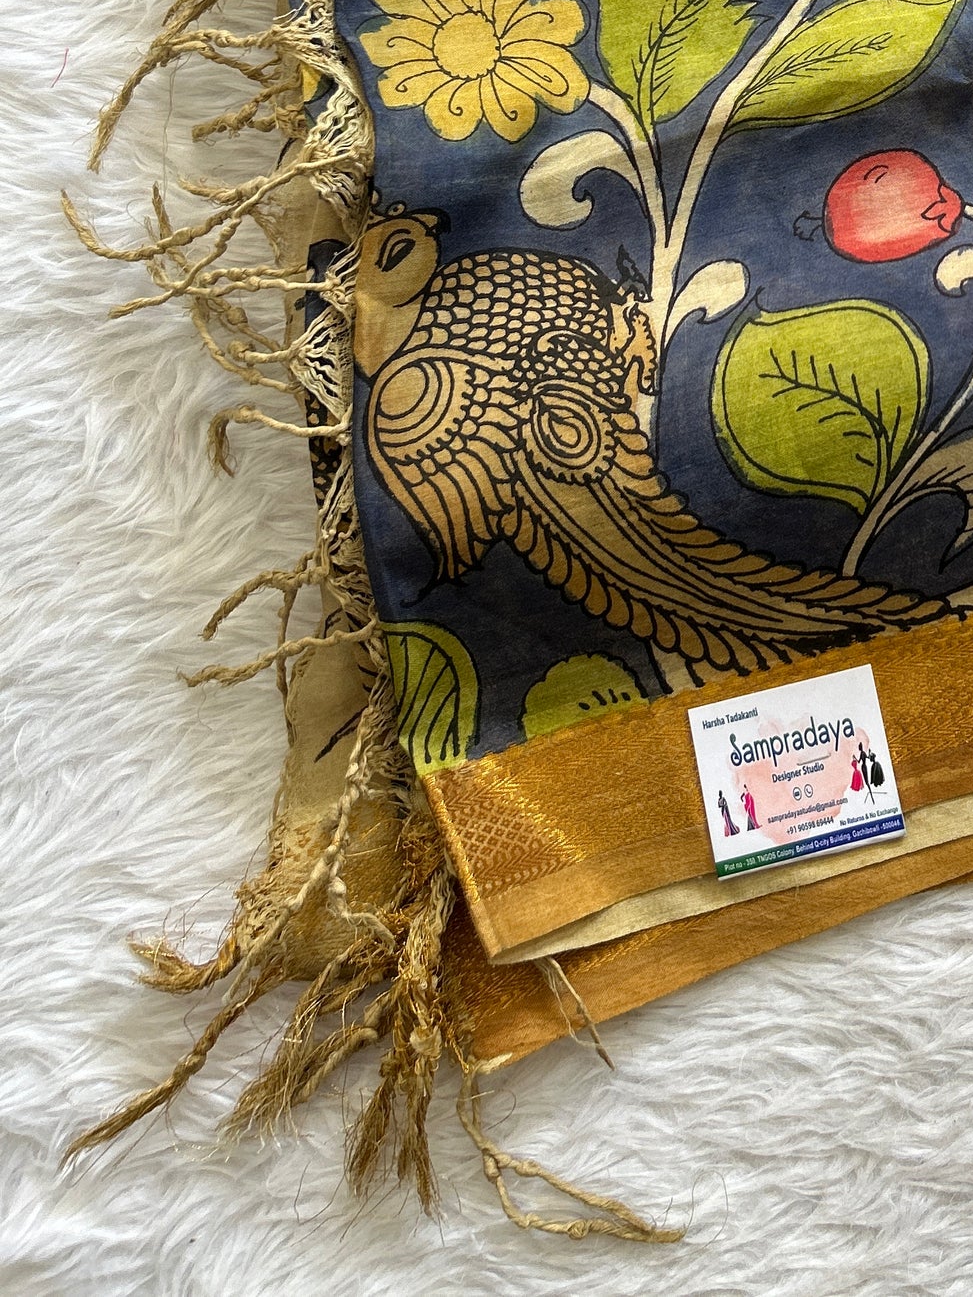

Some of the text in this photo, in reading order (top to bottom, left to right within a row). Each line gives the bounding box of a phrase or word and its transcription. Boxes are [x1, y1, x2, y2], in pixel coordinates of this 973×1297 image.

[702, 707, 759, 730] Harsha Tadakanti
[729, 716, 855, 767] Sampradaya
[772, 762, 825, 783] Designer Studio
[840, 819, 846, 827] No
[846, 815, 865, 825] Returns
[870, 811, 877, 819] No
[877, 807, 899, 817] Exchange
[786, 826, 797, 835] +91
[795, 841, 814, 852] Behind
